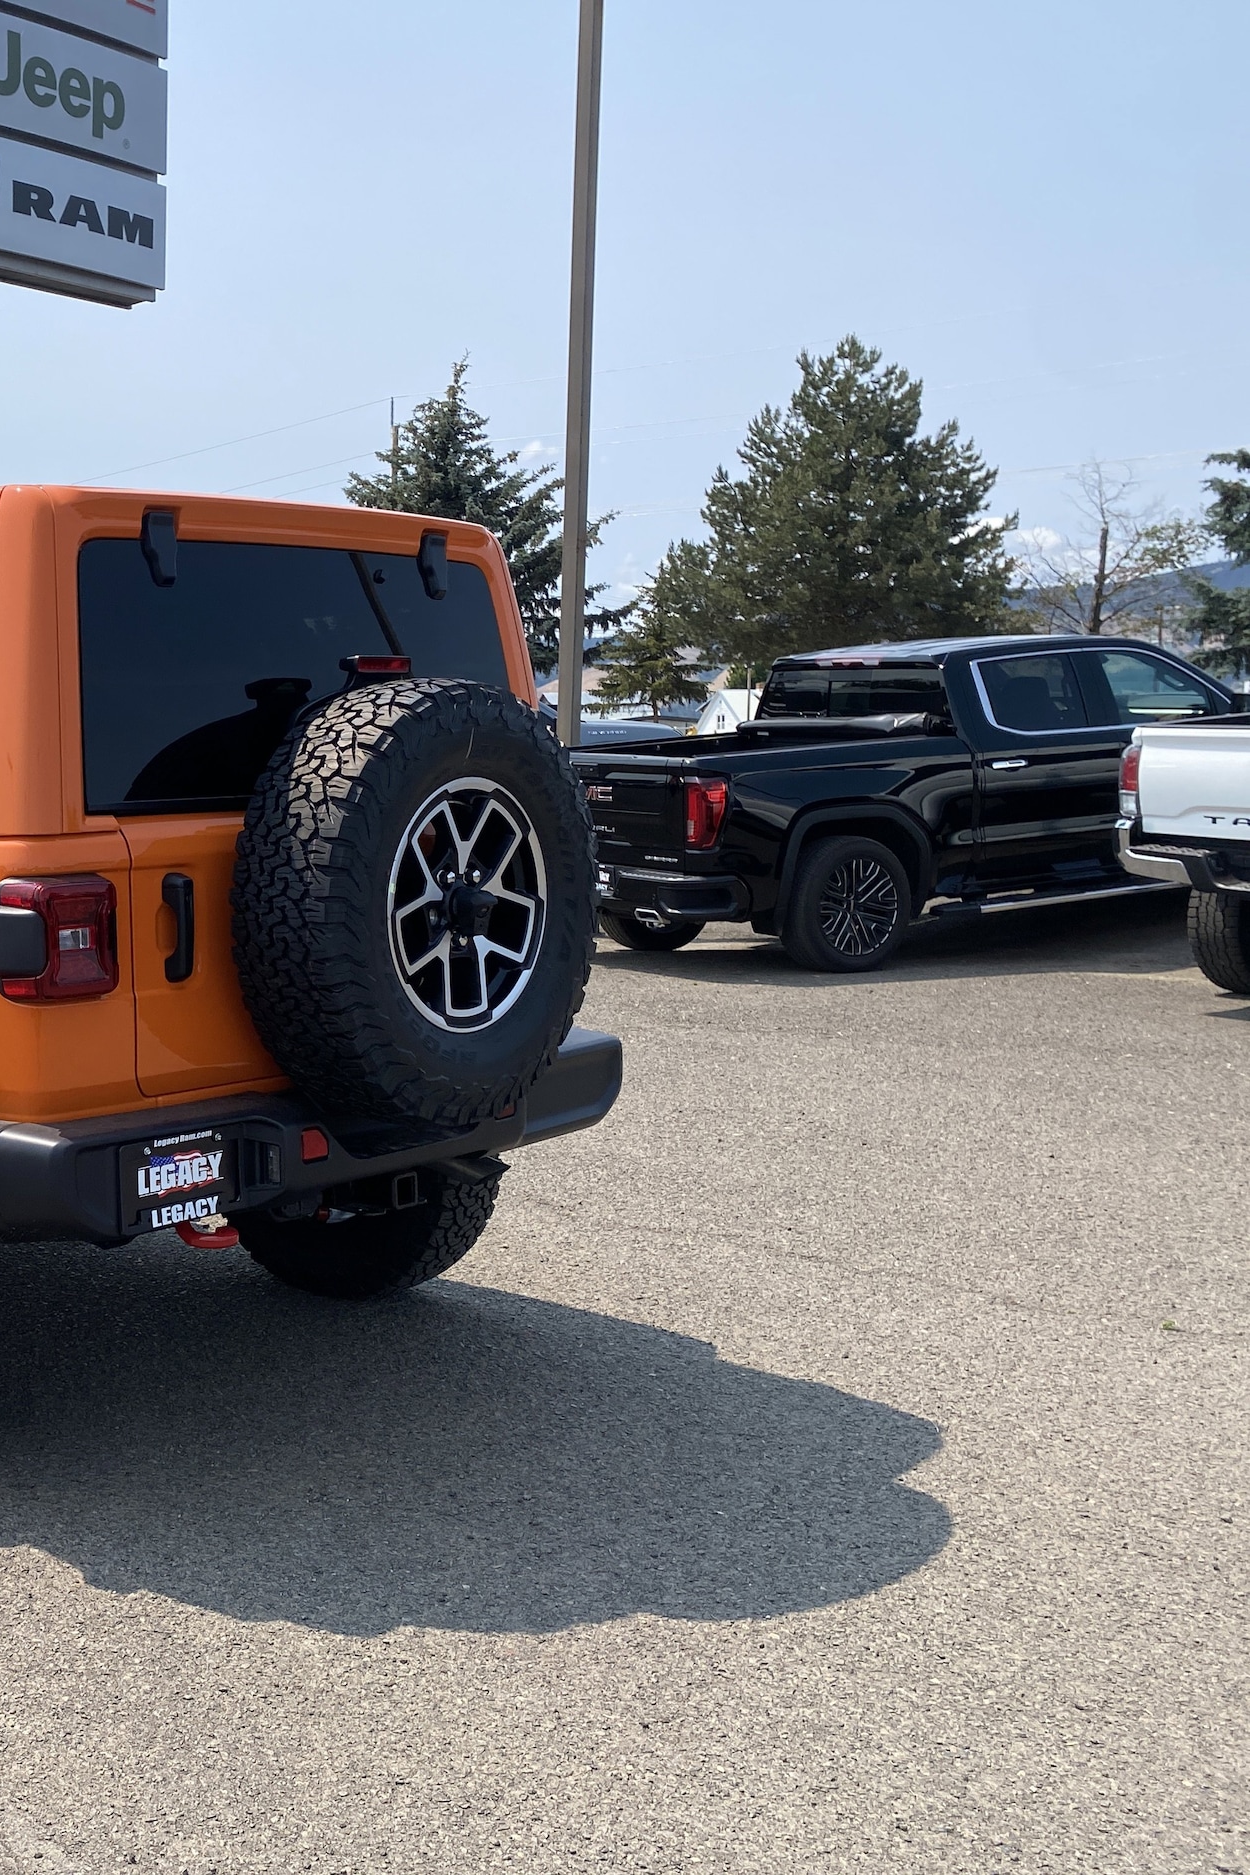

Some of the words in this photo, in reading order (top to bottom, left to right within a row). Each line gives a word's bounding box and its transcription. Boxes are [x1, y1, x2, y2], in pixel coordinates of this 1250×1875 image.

[12, 180, 154, 249] RAM
[137, 1152, 223, 1196] LEGACY
[151, 1195, 219, 1228] LEGACY
